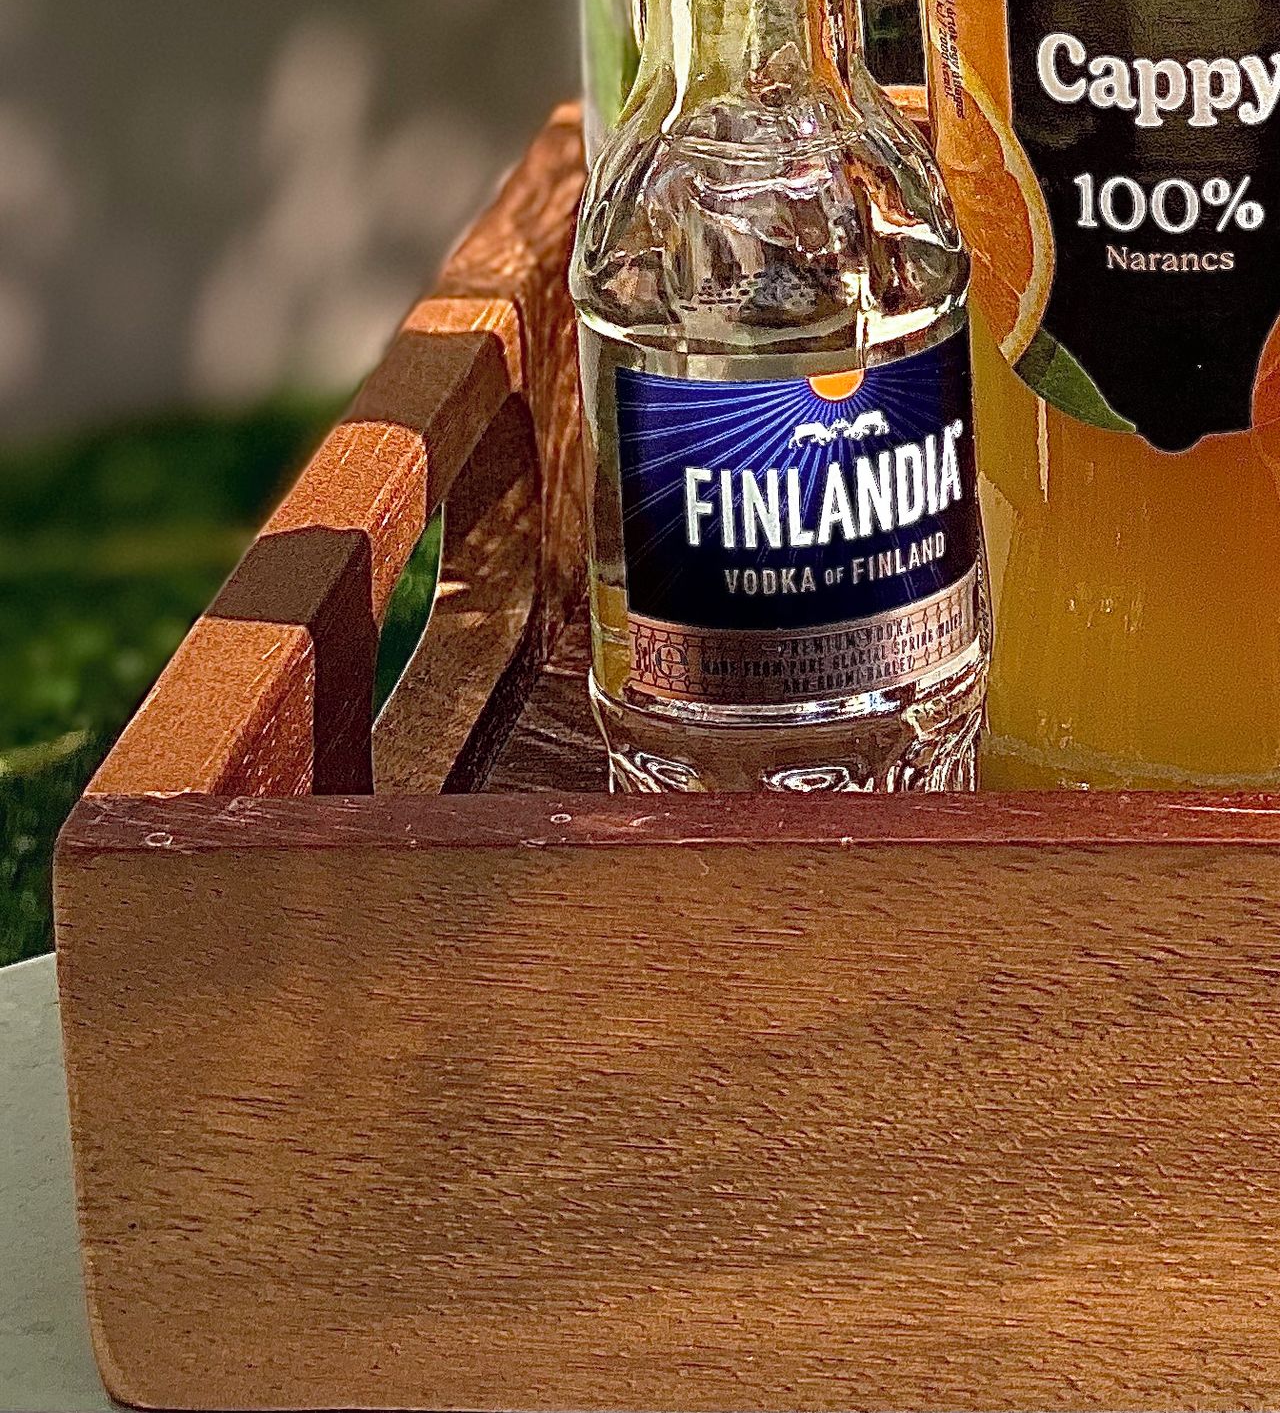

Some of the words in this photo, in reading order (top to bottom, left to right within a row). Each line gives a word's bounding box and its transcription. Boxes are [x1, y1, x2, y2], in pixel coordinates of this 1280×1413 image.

[1073, 173, 1266, 234] 100%
[1105, 245, 1236, 273] Narancs
[724, 566, 817, 597] VODKA
[825, 565, 845, 586] OF
[852, 531, 947, 585] FINLAND
